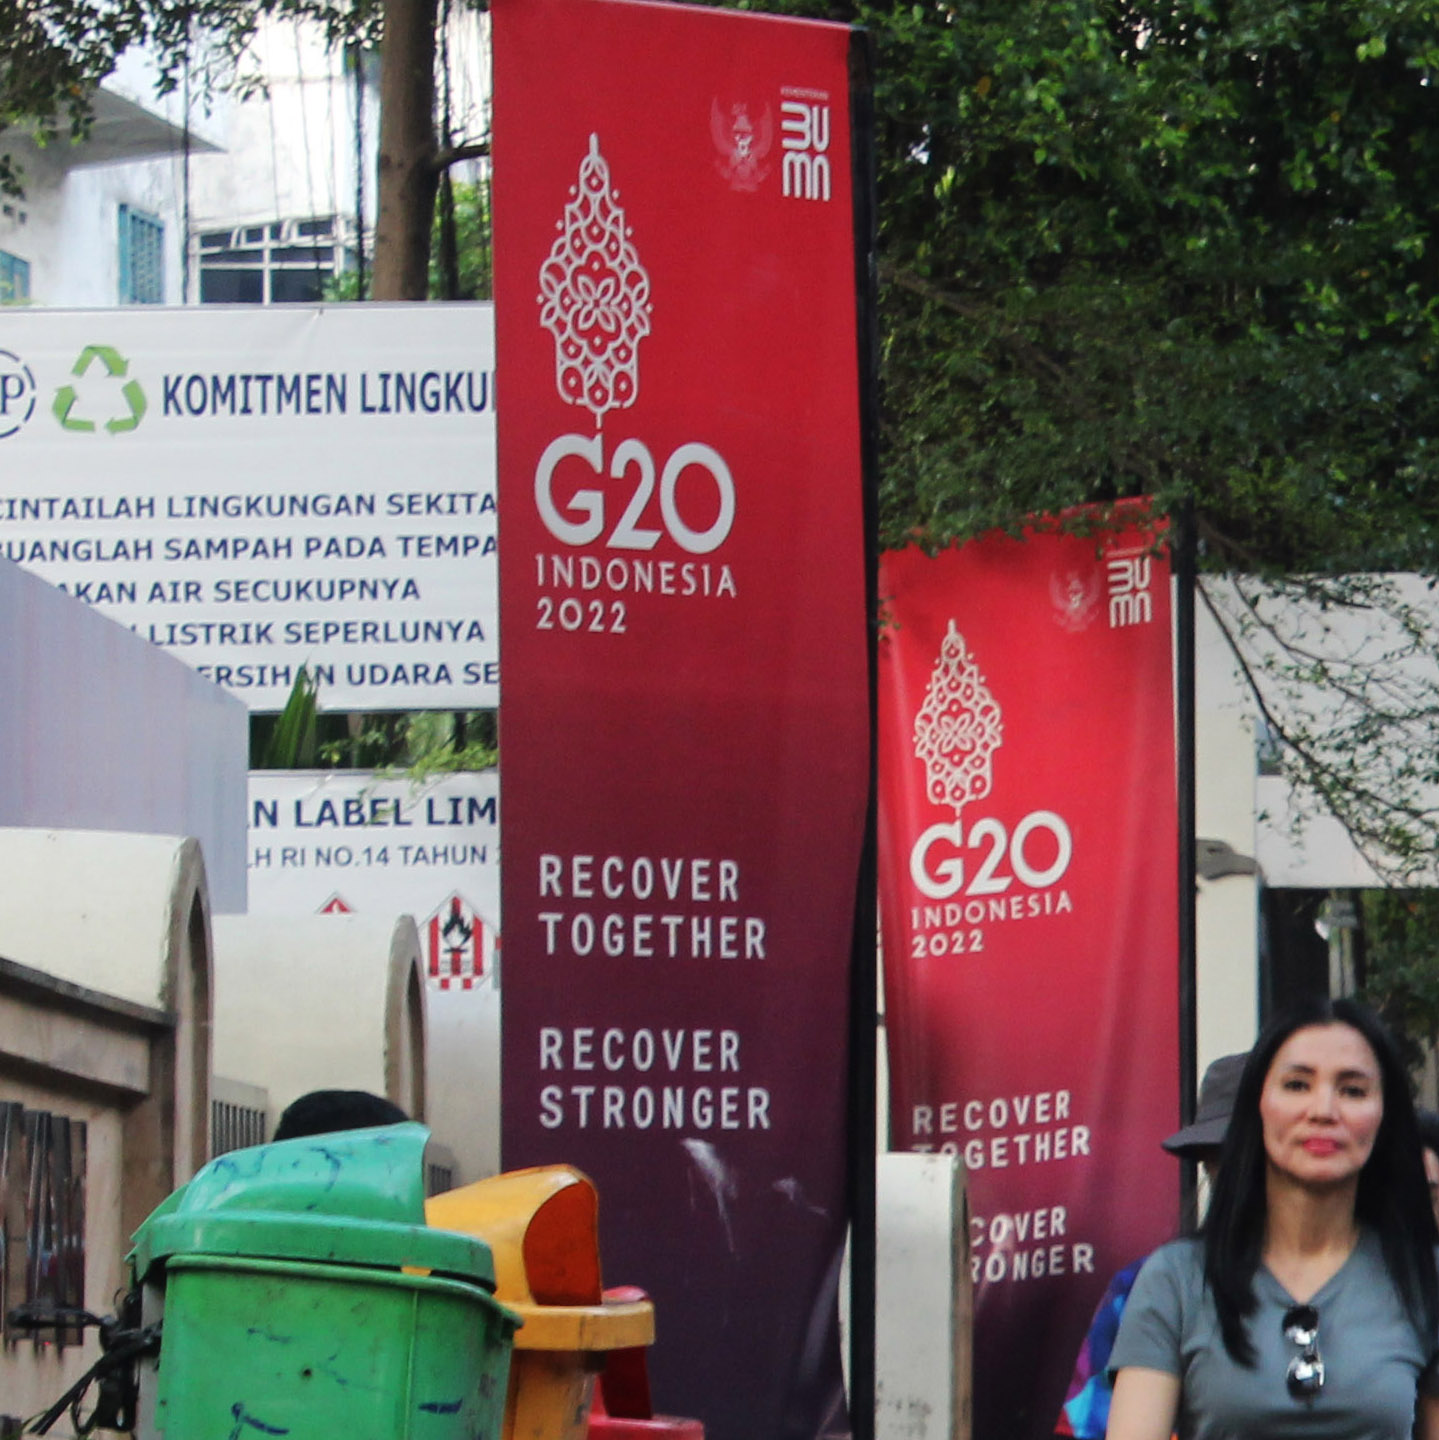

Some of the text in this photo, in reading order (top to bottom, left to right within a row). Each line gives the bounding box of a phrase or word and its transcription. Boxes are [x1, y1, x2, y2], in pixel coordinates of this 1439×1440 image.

[162, 370, 497, 416] KOMITMEN LINGKU
[0, 496, 155, 520] INTAILAH
[167, 495, 375, 518] LINGKUNGAN
[534, 432, 736, 554] G20
[0, 534, 498, 563] UANGLAH SAMPAH PADA TEMPA
[147, 581, 204, 603] AIR
[213, 577, 421, 602] SECUKUPNYA
[535, 553, 737, 599] INDONESIA
[150, 621, 274, 646] LISTRIK
[284, 619, 486, 645] SEPERLUNYA
[536, 596, 627, 634] 2022
[197, 661, 499, 689] RSIHN UDARA SE
[247, 796, 497, 829] N LABEL LIM
[248, 846, 272, 869] H
[281, 846, 306, 868] RI
[400, 844, 487, 866] TAHUN
[909, 810, 1073, 899] G20
[539, 853, 740, 902] RECOVER
[911, 889, 1073, 930] INDONESIA
[537, 911, 767, 960] TOGETHER
[911, 929, 985, 959] 2022
[539, 1026, 741, 1073] RECOVER
[538, 1084, 772, 1130] STRONGER
[911, 1089, 1071, 1135] RECOVER
[911, 1125, 1091, 1170] GETHER
